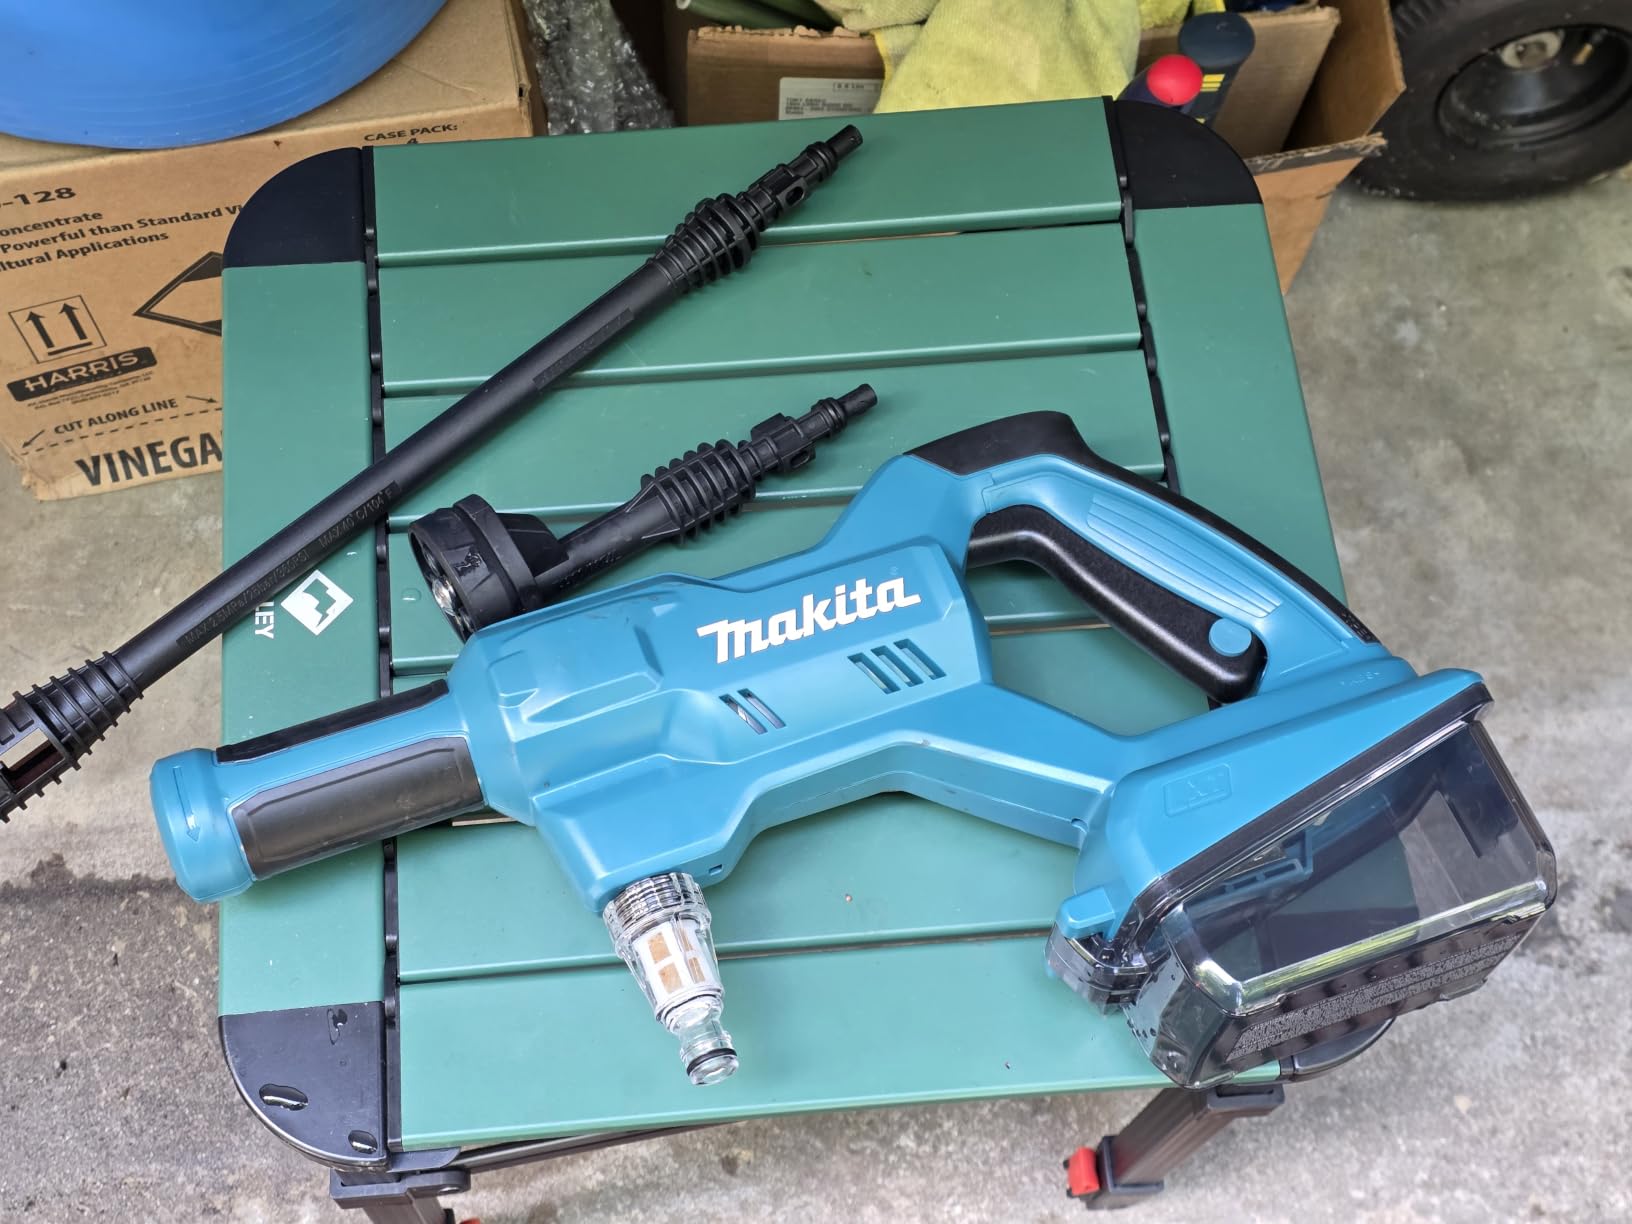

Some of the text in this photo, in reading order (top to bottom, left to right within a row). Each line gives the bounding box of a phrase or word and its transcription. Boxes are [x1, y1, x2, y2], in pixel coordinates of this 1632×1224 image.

[364, 124, 458, 141] CASE PACK:
[0, 228, 86, 254] Powerful
[88, 222, 134, 236] than
[137, 207, 223, 229] Standard
[0, 232, 169, 273] ltural Applications
[25, 351, 139, 392] HARRIS
[54, 398, 178, 435] CUT ALONG LINE
[75, 429, 222, 487] VINEGA
